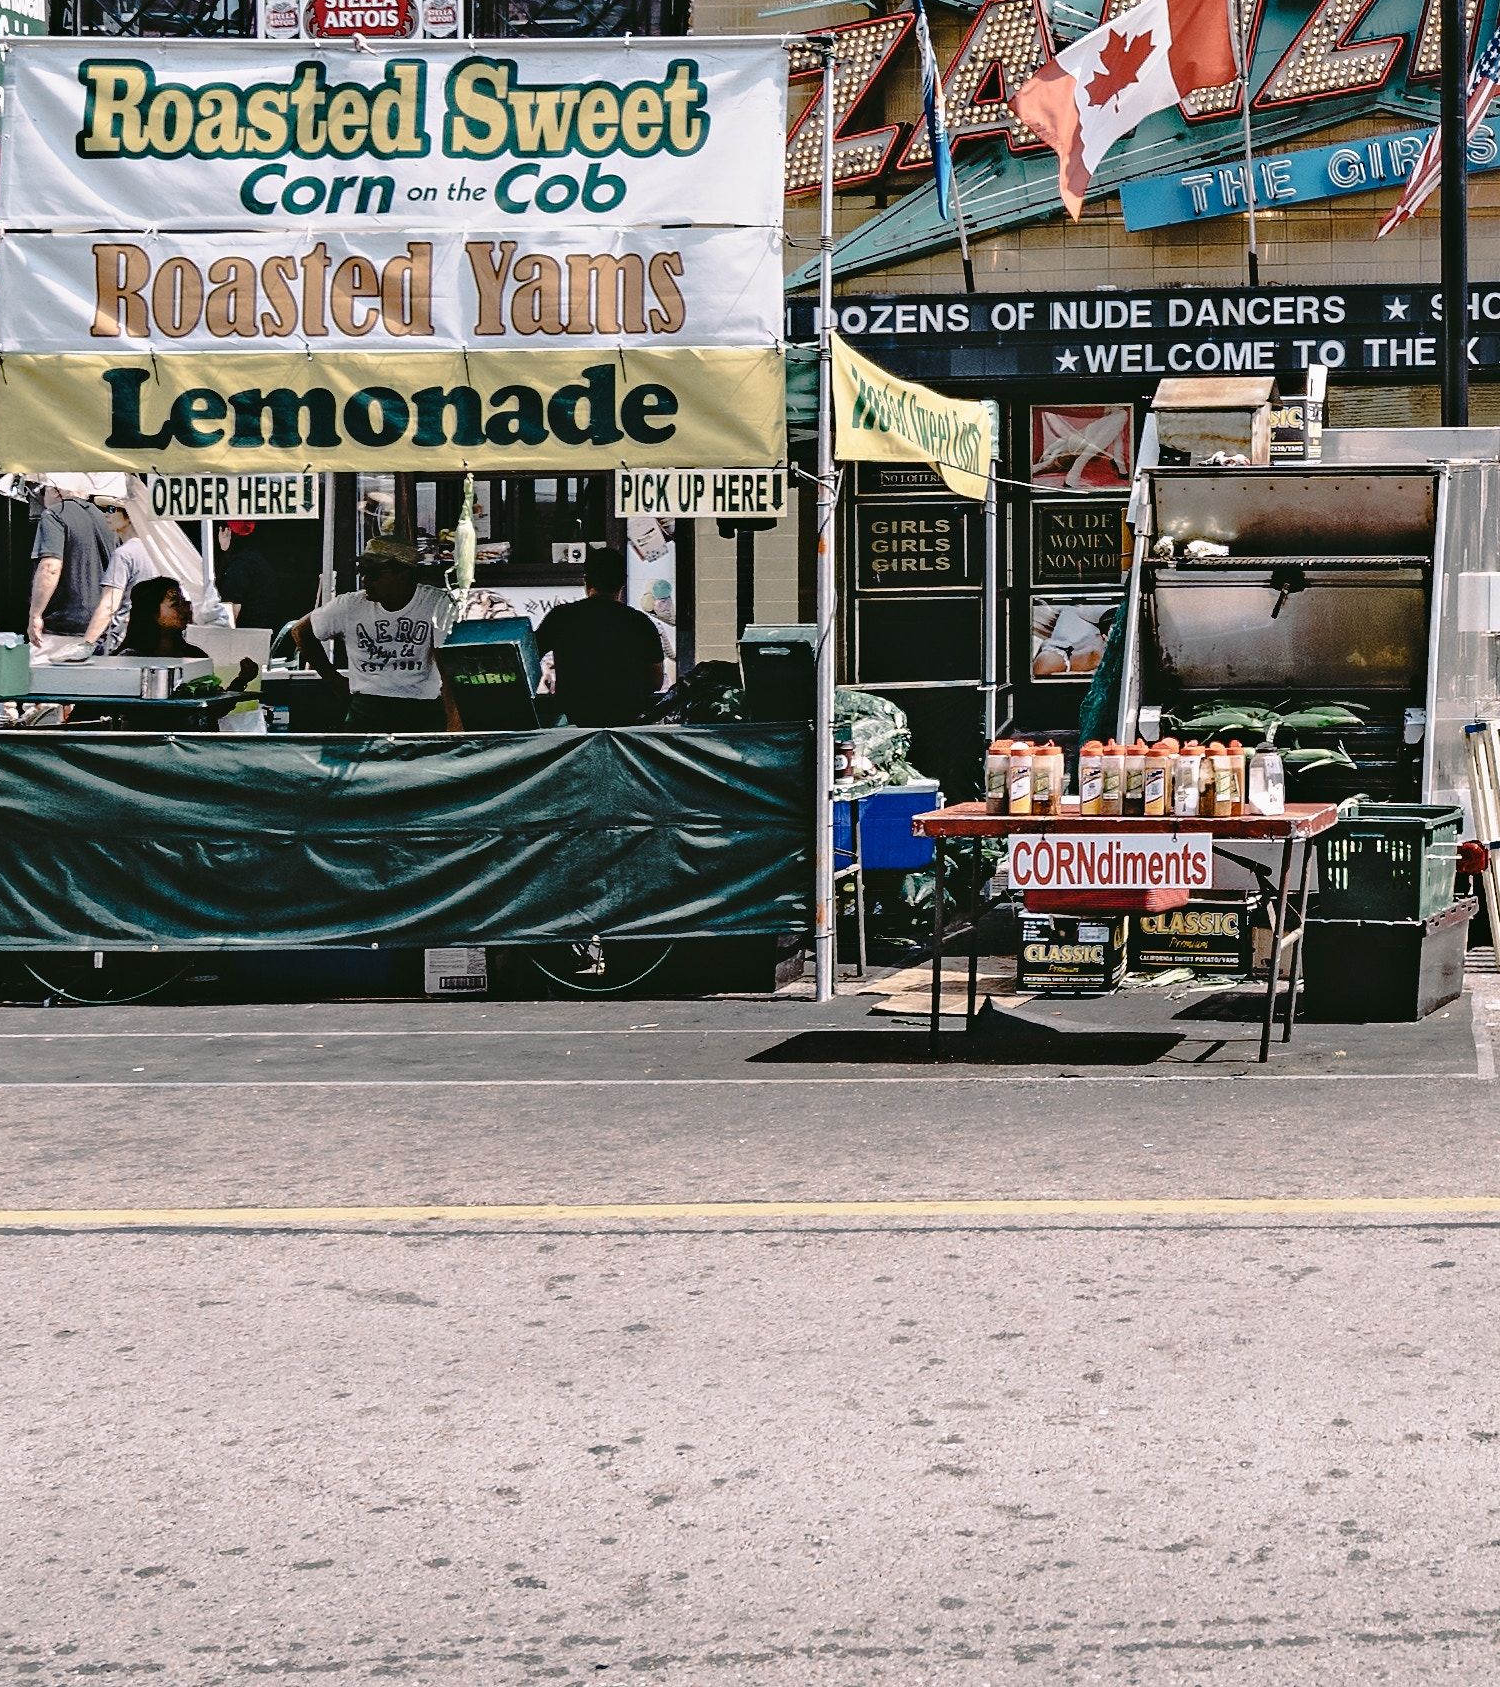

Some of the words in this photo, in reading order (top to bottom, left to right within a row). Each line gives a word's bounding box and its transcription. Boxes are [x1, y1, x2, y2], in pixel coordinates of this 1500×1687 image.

[324, 10, 399, 28] ARTOIS
[75, 58, 431, 160] Roasted
[442, 55, 711, 160] Sweet
[1182, 160, 1297, 213] THE
[1327, 124, 1500, 192] GIRS
[240, 164, 395, 215] Corn
[407, 182, 439, 202] on
[446, 178, 487, 202] the
[495, 163, 627, 214] Cob
[91, 242, 436, 339] Roasted
[467, 240, 687, 338] Yams
[813, 302, 970, 335] DOZENS
[990, 301, 1035, 331] OF
[1053, 298, 1152, 330] NUDE
[1168, 295, 1347, 328] DANCERS
[1084, 337, 1276, 374] WELCOME
[1292, 336, 1345, 368] TO
[1366, 334, 1436, 367] THE
[101, 365, 680, 451] Lemonade
[152, 476, 229, 516] ORDER
[237, 475, 297, 513] HERE
[620, 473, 667, 512] PICK
[677, 473, 704, 512] UP
[713, 472, 768, 512] HERE
[871, 518, 951, 534] GIRLS
[1049, 534, 1115, 548] WOMEN
[1051, 514, 1114, 529] NUDE
[871, 538, 951, 553] GIRLS
[871, 556, 951, 573] GIRLS
[356, 617, 429, 649] AERO
[1012, 841, 1207, 886] CORNdiments
[1140, 912, 1240, 936] CLASSIC
[1024, 944, 1104, 964] CLASSIC
